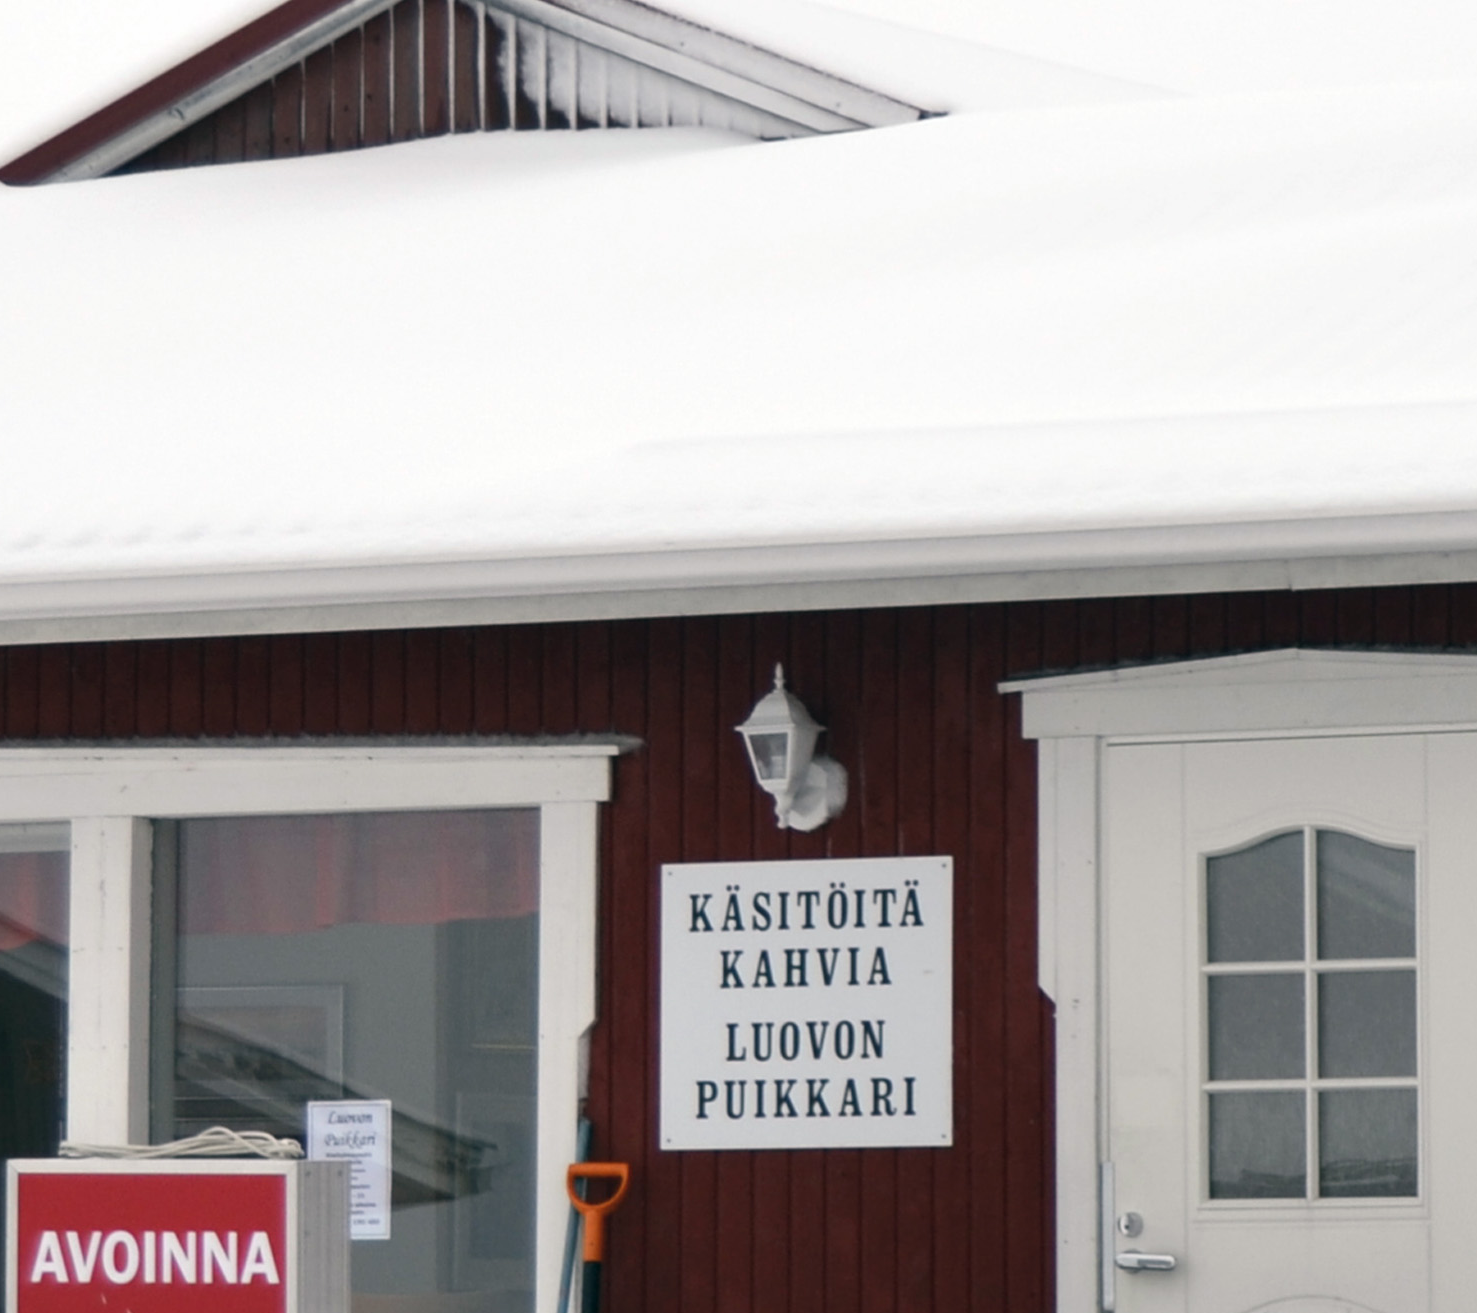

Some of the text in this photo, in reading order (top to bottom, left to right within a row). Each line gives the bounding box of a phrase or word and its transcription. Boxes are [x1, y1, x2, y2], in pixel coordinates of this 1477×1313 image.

[689, 879, 924, 933] KÄSITÖITÄ
[720, 946, 892, 989] KAHVIA
[726, 1019, 885, 1062] LUOVON
[696, 1076, 916, 1120] PUIKKARI
[30, 1230, 280, 1285] AVOINNA
